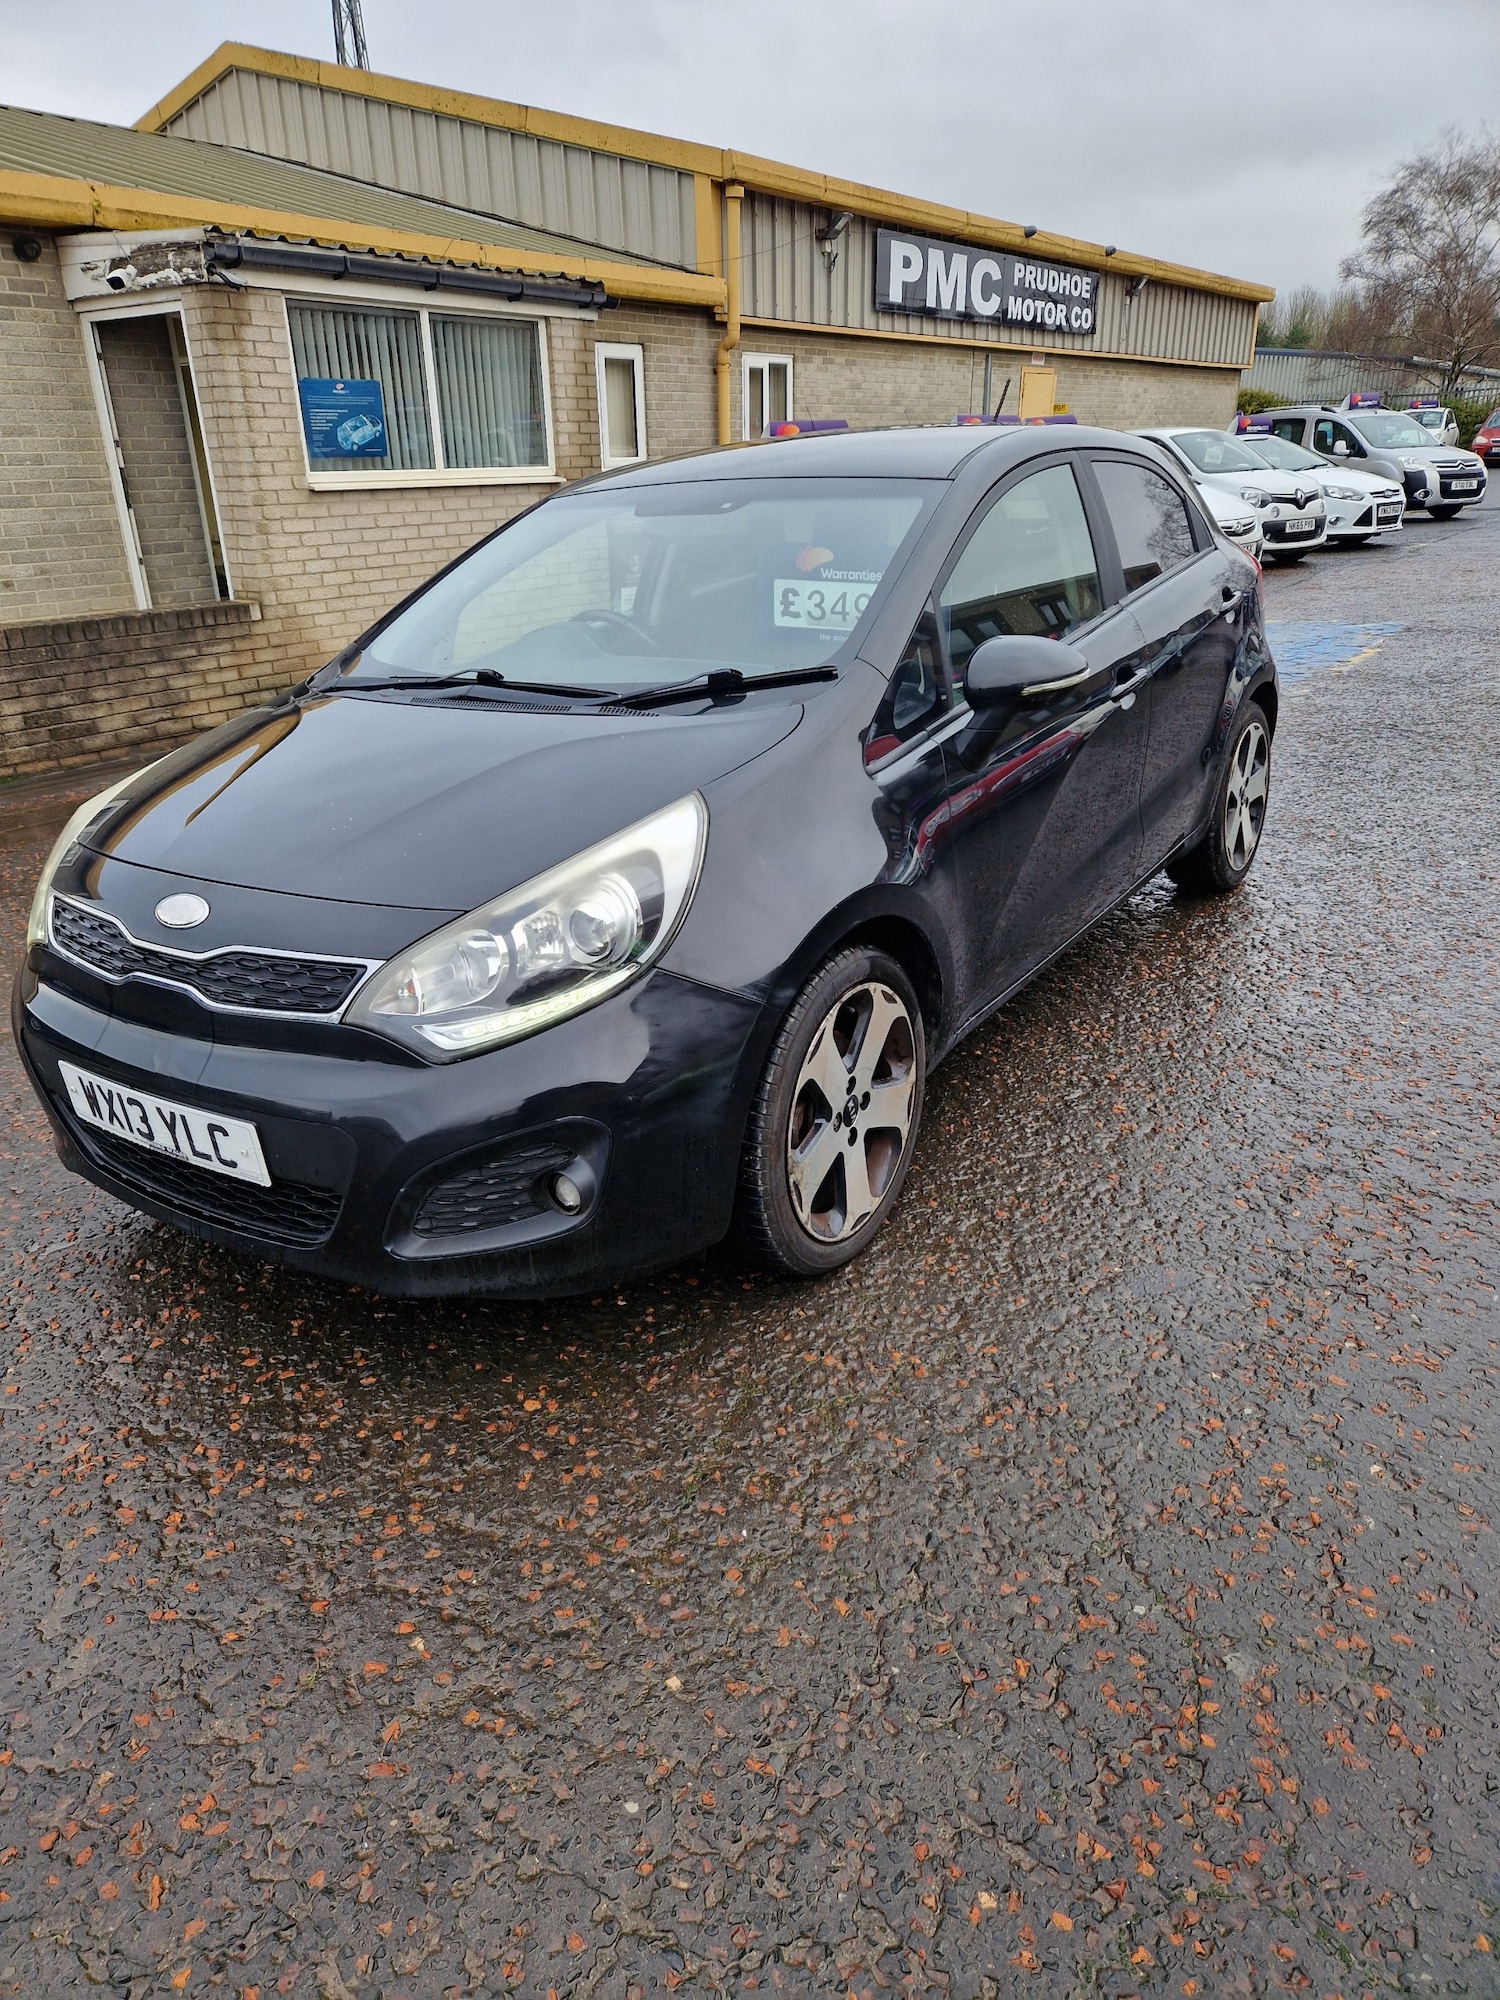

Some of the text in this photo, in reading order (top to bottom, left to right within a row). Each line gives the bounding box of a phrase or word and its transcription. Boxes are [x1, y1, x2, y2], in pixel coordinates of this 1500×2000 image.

[889, 239, 1003, 316] PMC
[1013, 261, 1092, 299] PRUDHOE
[1007, 295, 1093, 330] MOTOR CO
[820, 567, 884, 582] Warranties
[77, 1075, 238, 1169] WX13 YLC
